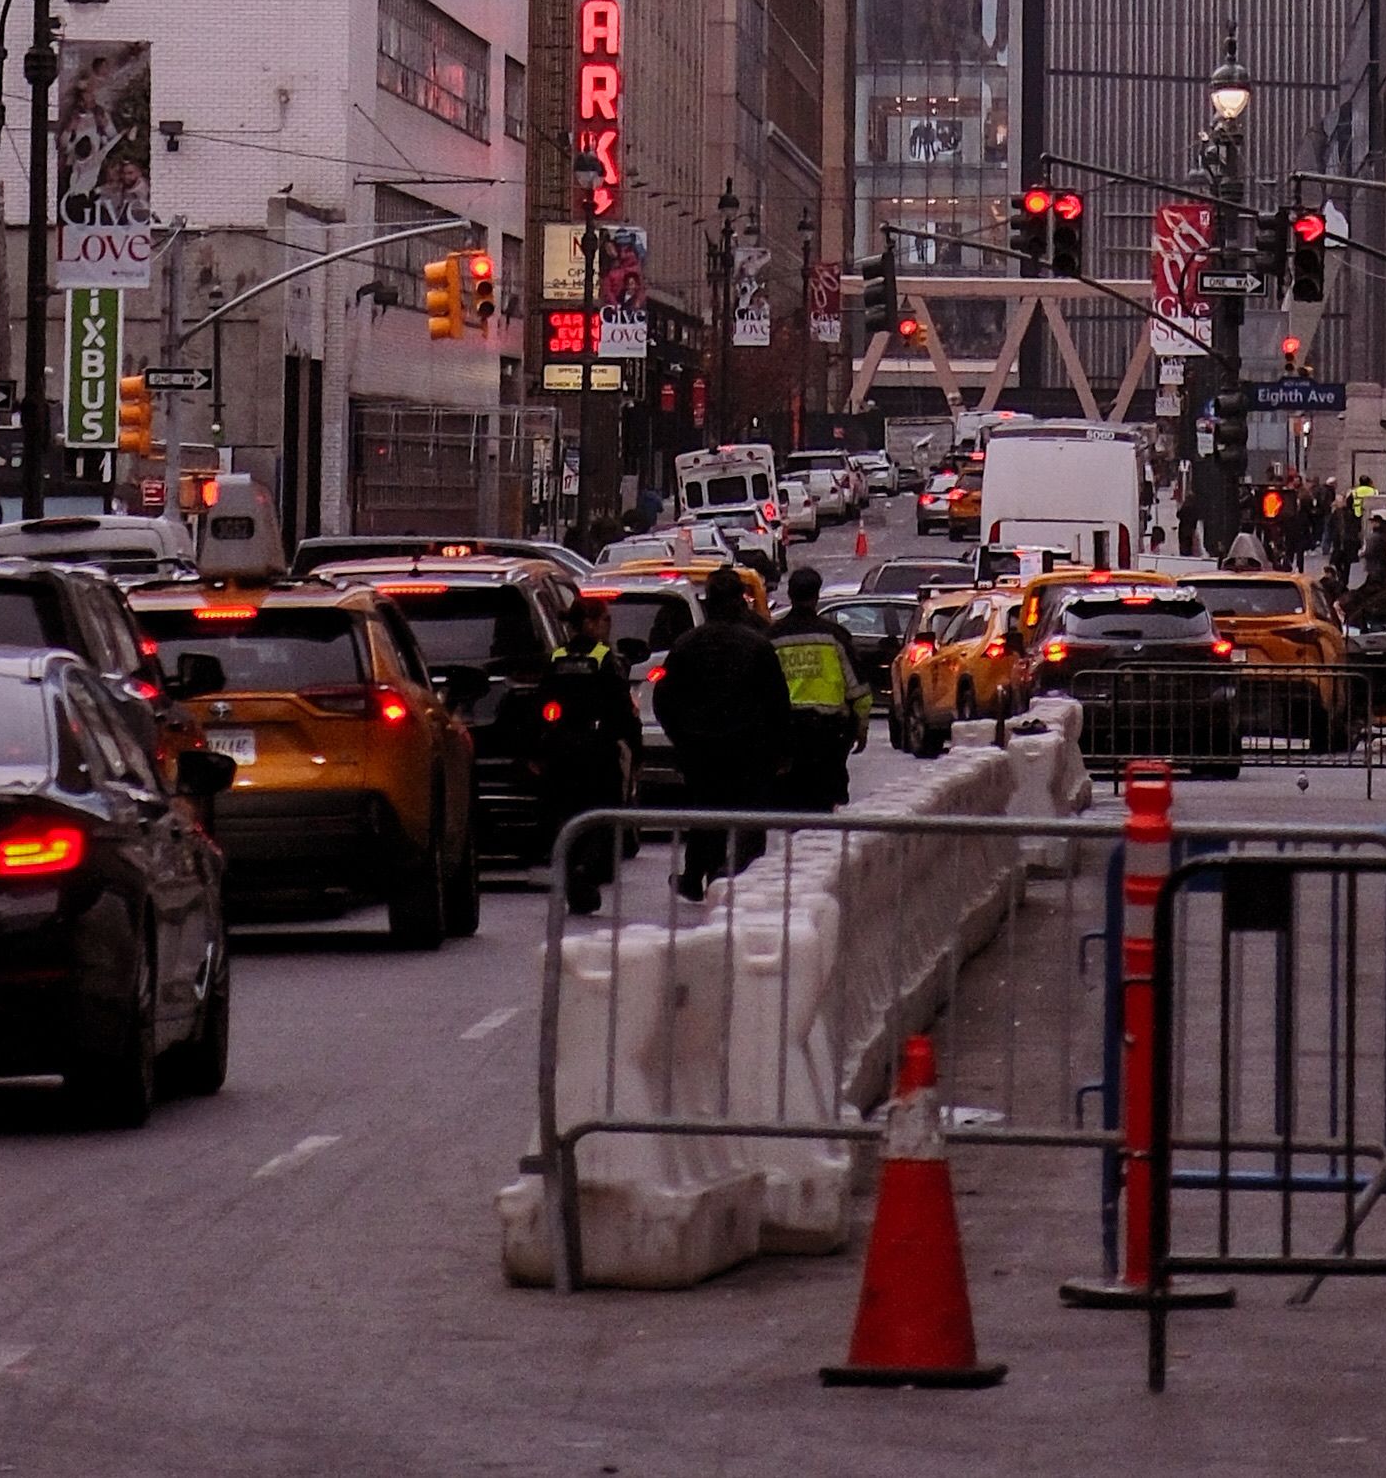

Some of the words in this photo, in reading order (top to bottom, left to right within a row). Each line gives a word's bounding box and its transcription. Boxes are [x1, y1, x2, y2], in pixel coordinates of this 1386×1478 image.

[59, 188, 151, 226] Give
[57, 224, 151, 262] Love
[1209, 278, 1228, 287] ONE
[1236, 279, 1256, 287] WAY
[599, 304, 647, 325] Give
[183, 375, 203, 385] WAY
[1256, 388, 1303, 407] Eighth
[1309, 389, 1336, 405] Ave
